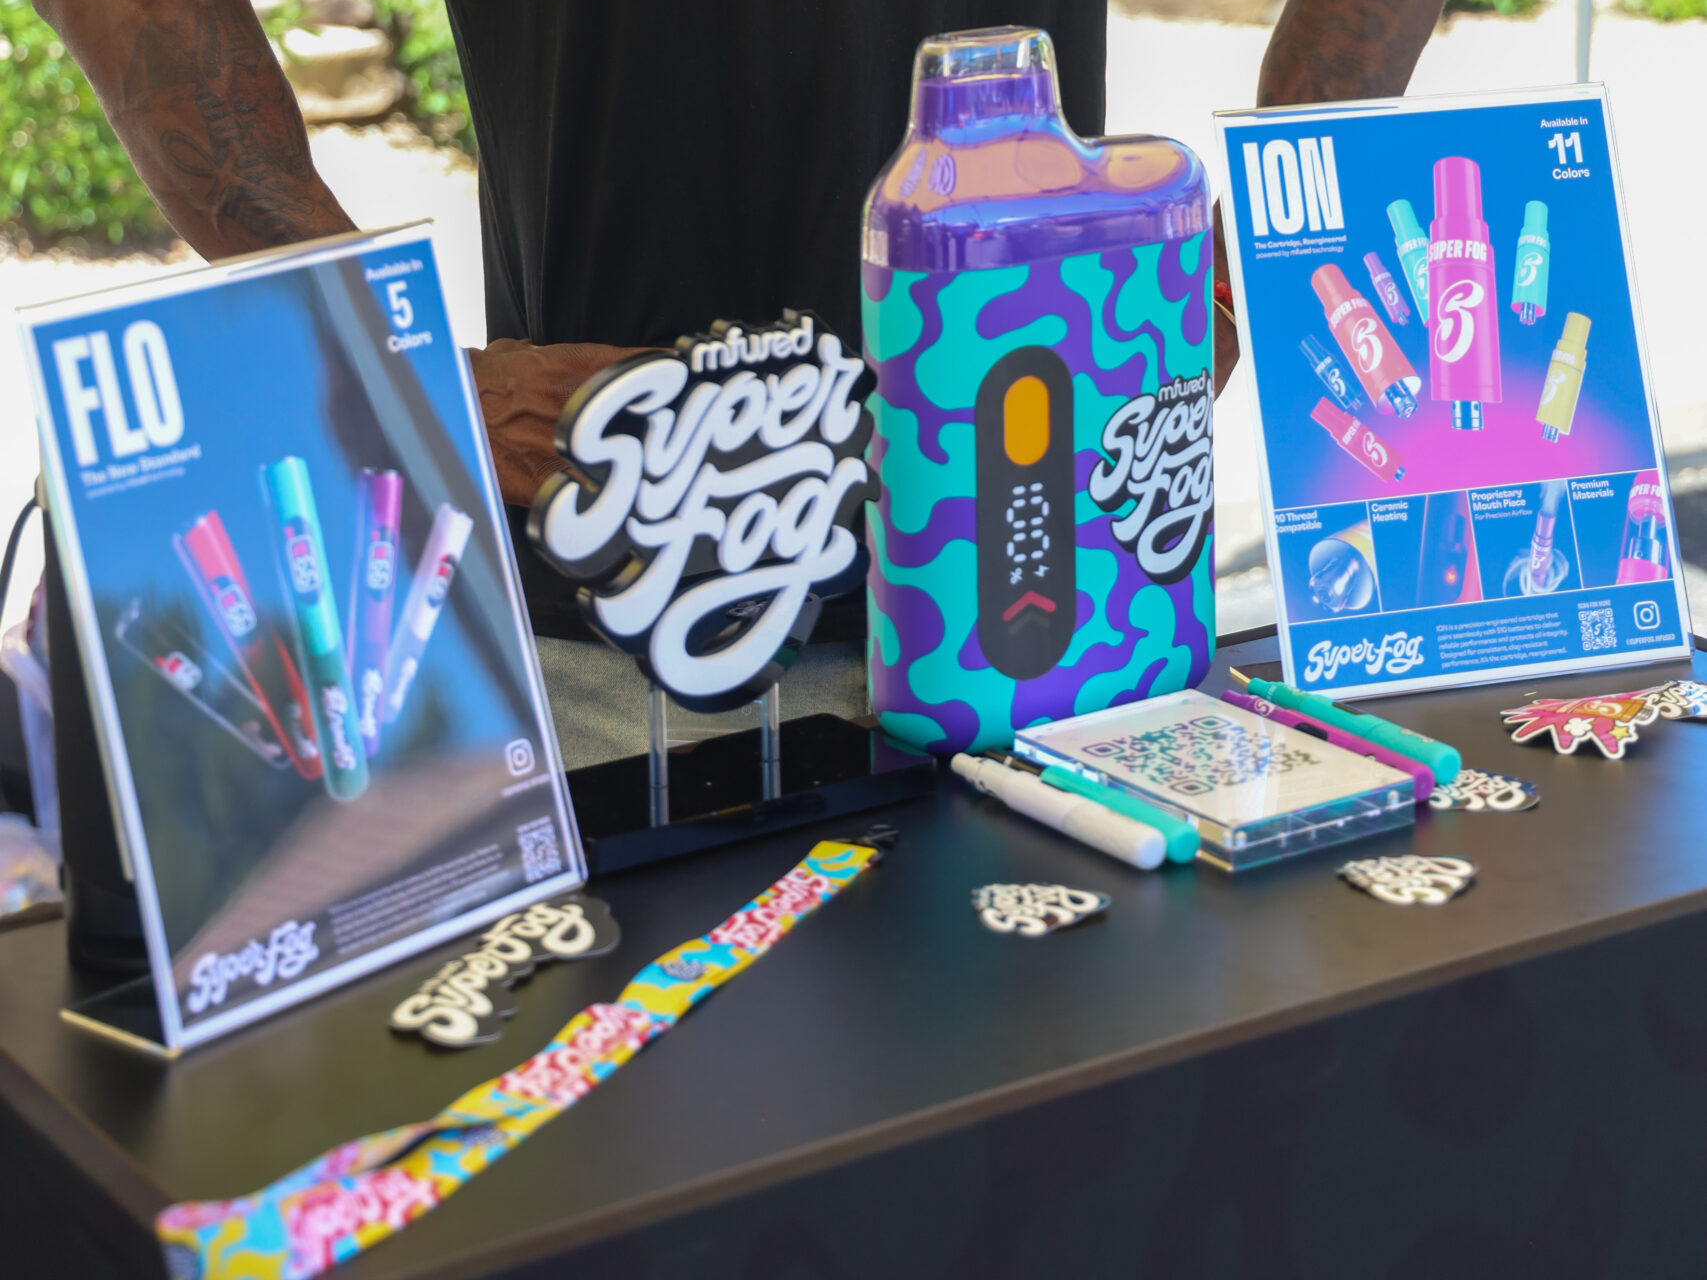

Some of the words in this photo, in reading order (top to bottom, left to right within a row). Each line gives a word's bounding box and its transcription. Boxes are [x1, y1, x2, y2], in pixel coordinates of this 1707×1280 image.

[1540, 117, 1579, 128] Available
[1579, 116, 1589, 126] In
[1548, 131, 1583, 164] 11
[1552, 167, 1590, 180] Colors
[1242, 136, 1345, 236] ION
[1254, 240, 1266, 249] The
[1429, 239, 1463, 263] SUPER
[1464, 239, 1488, 262] FOG
[387, 280, 414, 329] 5
[53, 320, 185, 467] FLO
[545, 333, 865, 560] Super
[1571, 480, 1609, 491] Premium
[1471, 488, 1522, 502] Proprietary
[1572, 488, 1614, 500] Materials
[1111, 436, 1214, 574] Fog
[1371, 501, 1408, 512] Ceramic
[1473, 499, 1502, 512] Mouth
[1503, 498, 1527, 508] Piece
[1275, 513, 1286, 524] 10
[1286, 510, 1318, 522] Thread
[1372, 511, 1408, 523] Heating
[594, 441, 868, 696] Fog
